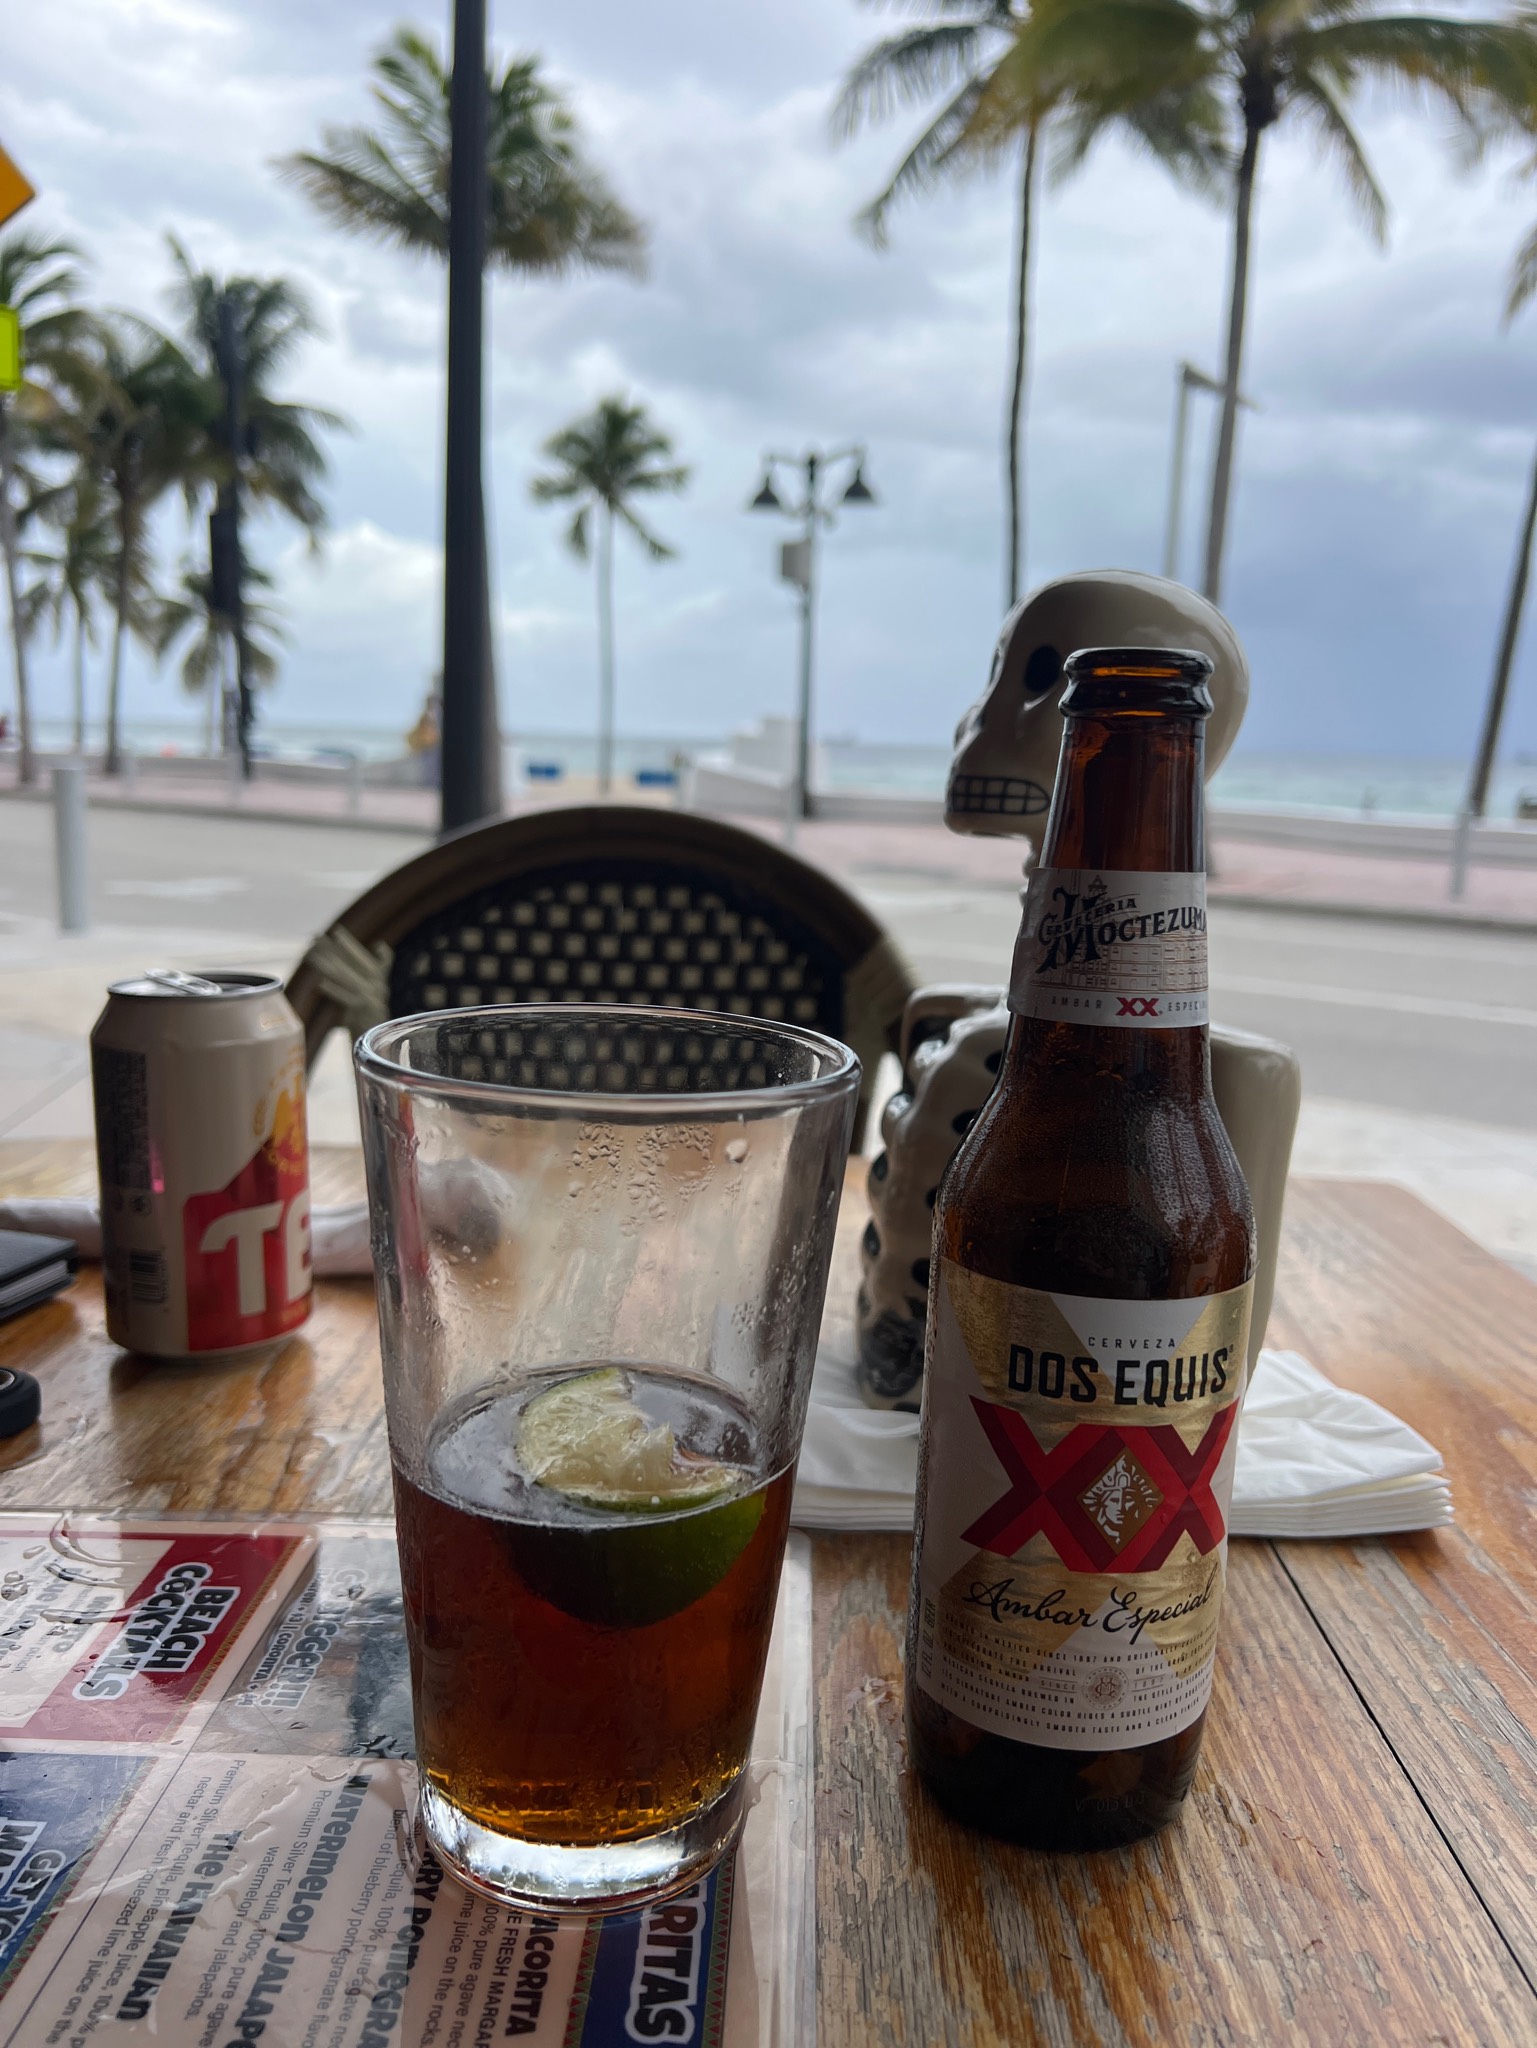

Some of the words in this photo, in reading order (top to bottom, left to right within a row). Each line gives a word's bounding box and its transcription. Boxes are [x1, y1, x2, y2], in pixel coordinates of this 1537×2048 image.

[1051, 996, 1102, 1009] AMBAR
[1115, 997, 1159, 1016] XX
[1088, 1336, 1176, 1349] CERVEZA
[1008, 1343, 1098, 1403] DOS
[1114, 1347, 1229, 1407] EQUIS
[960, 1395, 1239, 1573] XX
[961, 1578, 1098, 1627] Ambar
[1102, 1561, 1219, 1645] Especial
[79, 1564, 208, 1698] COCKTAILS
[144, 1588, 235, 1669] BEACH
[184, 1776, 212, 1810] nectar
[209, 1759, 247, 1805] Premium
[170, 1811, 191, 1833] and
[190, 1808, 219, 1840] Silver
[297, 1789, 333, 1839] Premium
[152, 1835, 181, 1865] fresh
[160, 1841, 200, 1885] Tequila,
[282, 1841, 308, 1874] Silver
[380, 1843, 393, 1856] of
[10, 1851, 62, 1901] GET
[236, 1846, 280, 1917] watermelon
[351, 1857, 391, 1916] blueberry
[115, 1866, 158, 1926] squeezed
[254, 1876, 293, 1924] Tequila,
[125, 1887, 170, 1951] pineapple
[222, 1920, 243, 1946] and
[368, 1906, 394, 1941] 100%
[449, 1920, 473, 1953] juice
[97, 1928, 126, 1957] lime
[238, 1928, 267, 1963] 100%
[356, 1944, 377, 1976] pure
[469, 1940, 487, 1971] pure
[493, 1928, 519, 1977] FRESH
[75, 1959, 109, 1994] juice
[101, 1953, 138, 1991] juice,
[222, 1966, 246, 2000] pure
[316, 1918, 362, 2010] pomegranate
[442, 1956, 458, 1974] on
[505, 1917, 560, 2037] ACORITA
[62, 1995, 82, 2016] on
[338, 1979, 364, 2022] agave
[435, 1977, 455, 2002] the
[455, 1974, 478, 2017] agave
[199, 2002, 229, 2048] agave
